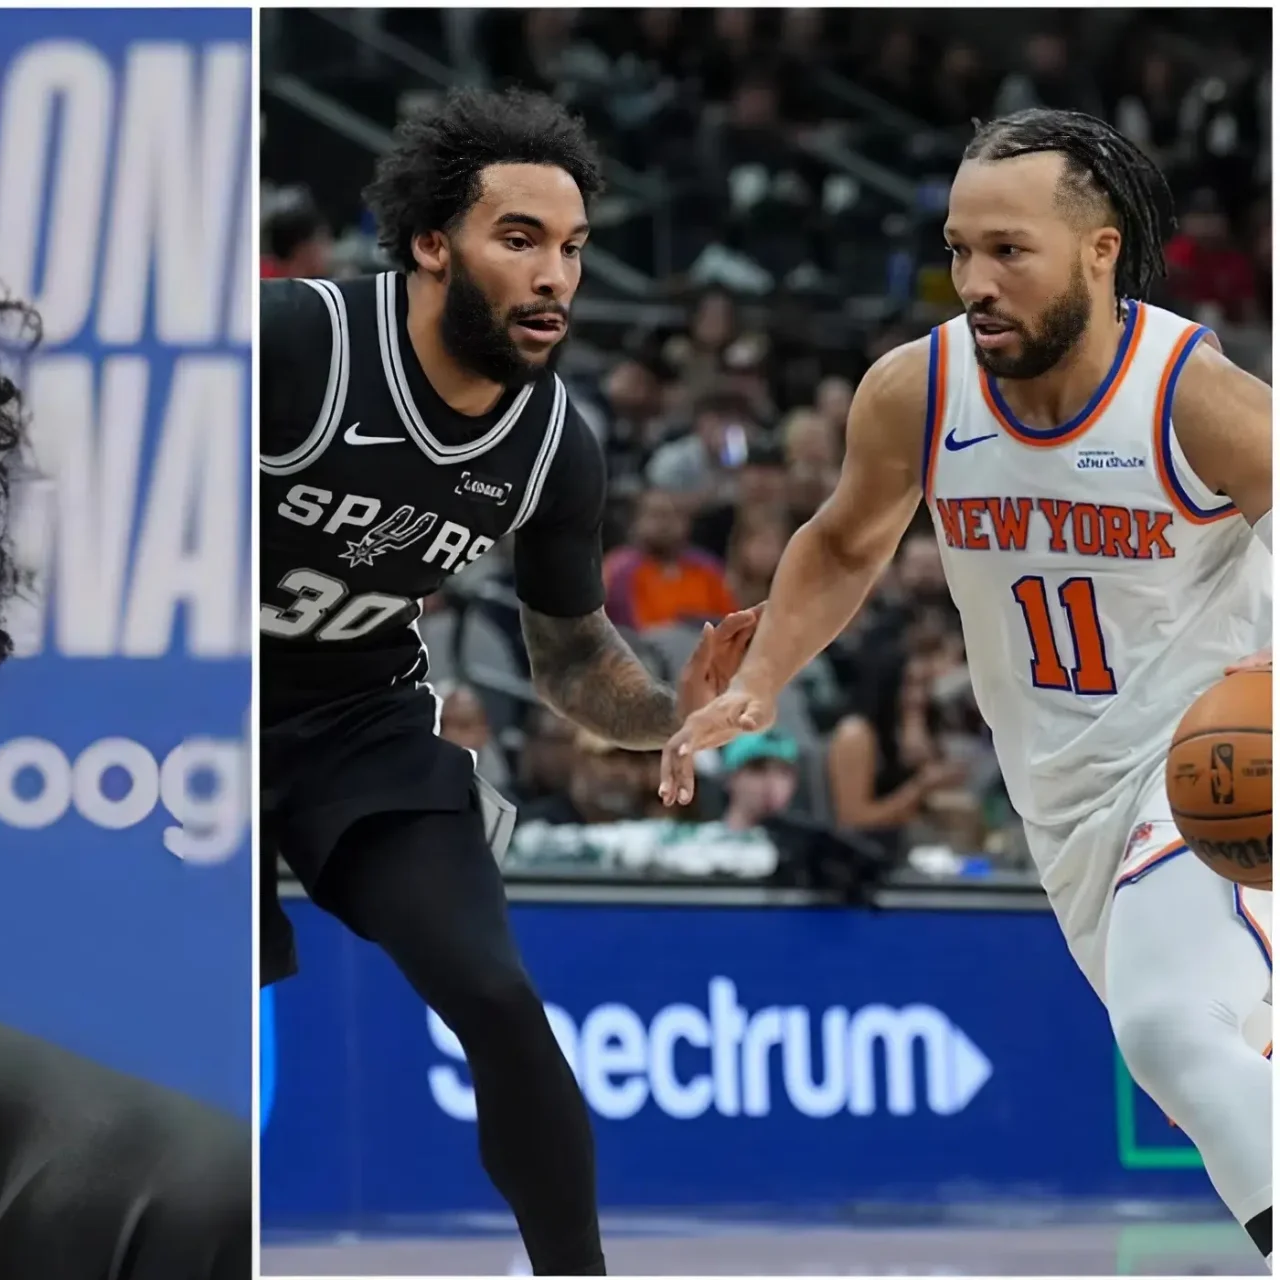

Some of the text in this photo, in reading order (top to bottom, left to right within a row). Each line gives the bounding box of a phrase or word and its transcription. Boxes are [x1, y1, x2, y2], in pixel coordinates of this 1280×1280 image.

[937, 497, 1176, 560] NEW YORK
[260, 567, 417, 642] 30
[1011, 575, 1118, 695] 11
[425, 976, 970, 1122] Sectrum
